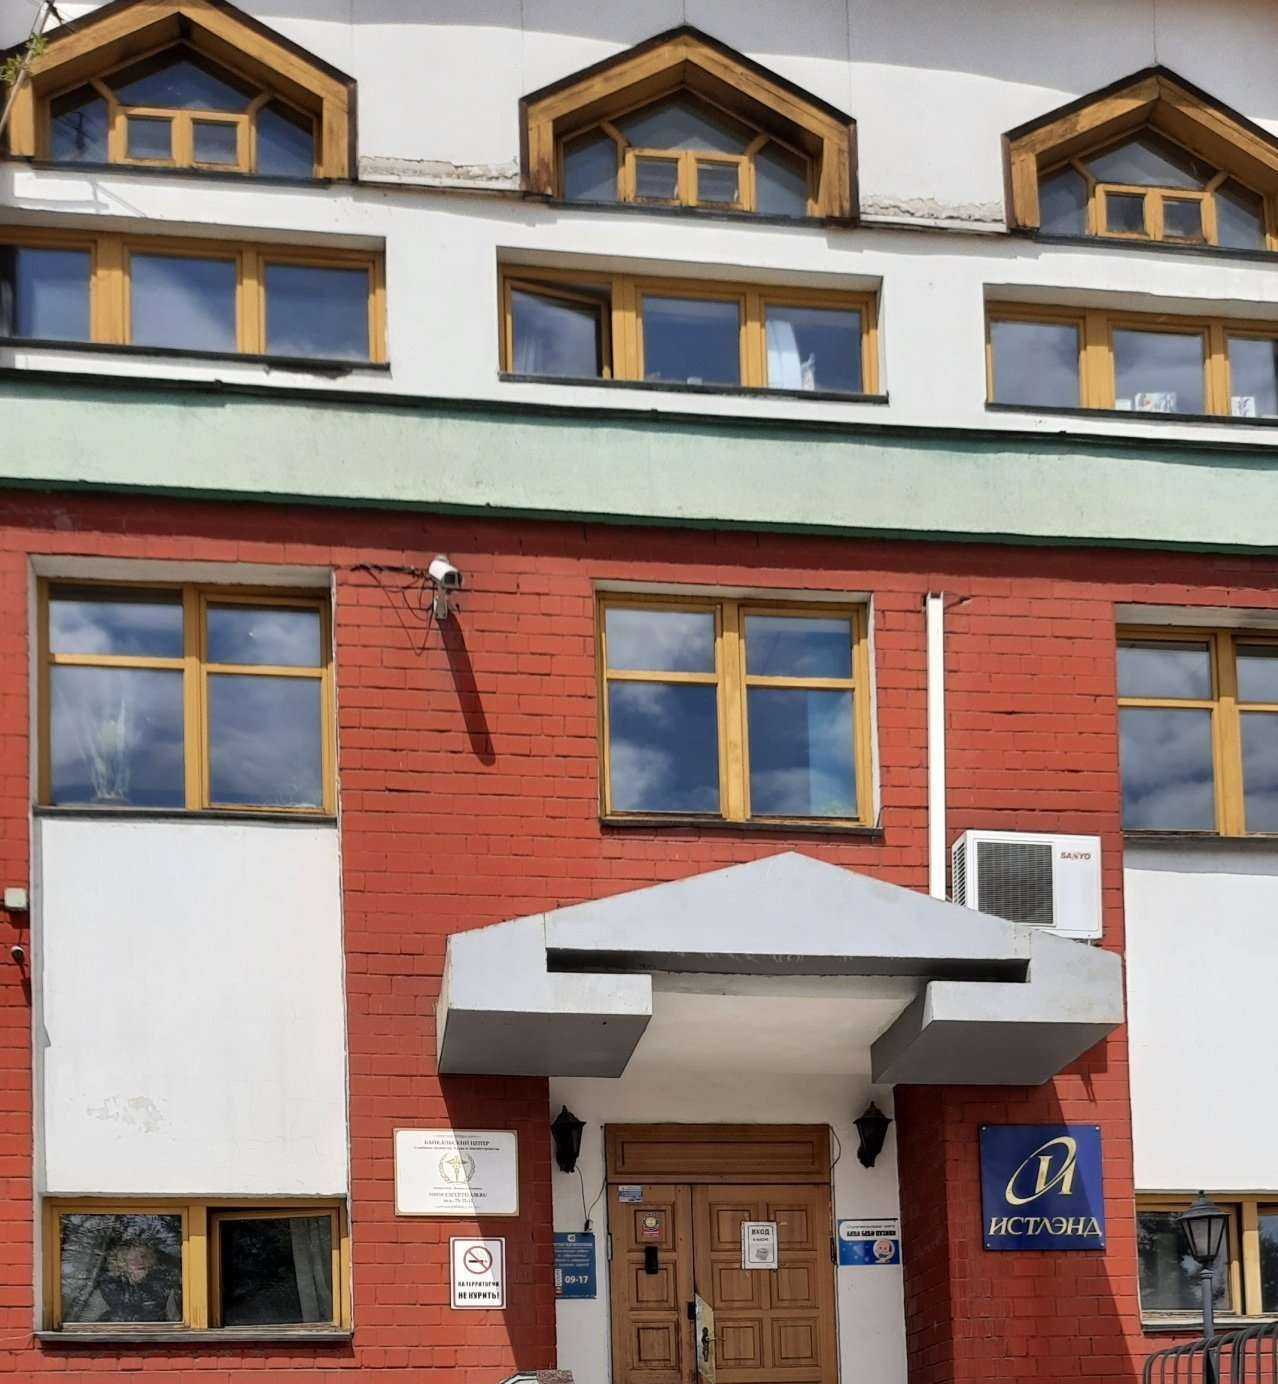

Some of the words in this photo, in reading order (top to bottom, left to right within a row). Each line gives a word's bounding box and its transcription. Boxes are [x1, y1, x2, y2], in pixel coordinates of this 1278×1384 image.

[1060, 851, 1092, 861] SANYO
[751, 1228, 770, 1236] ВХОД
[988, 1216, 1103, 1238] ИСТЛЭНД
[564, 1275, 589, 1285] 09-17
[458, 1291, 467, 1300] НЕ
[468, 1291, 500, 1300] КУРИТЬ!
